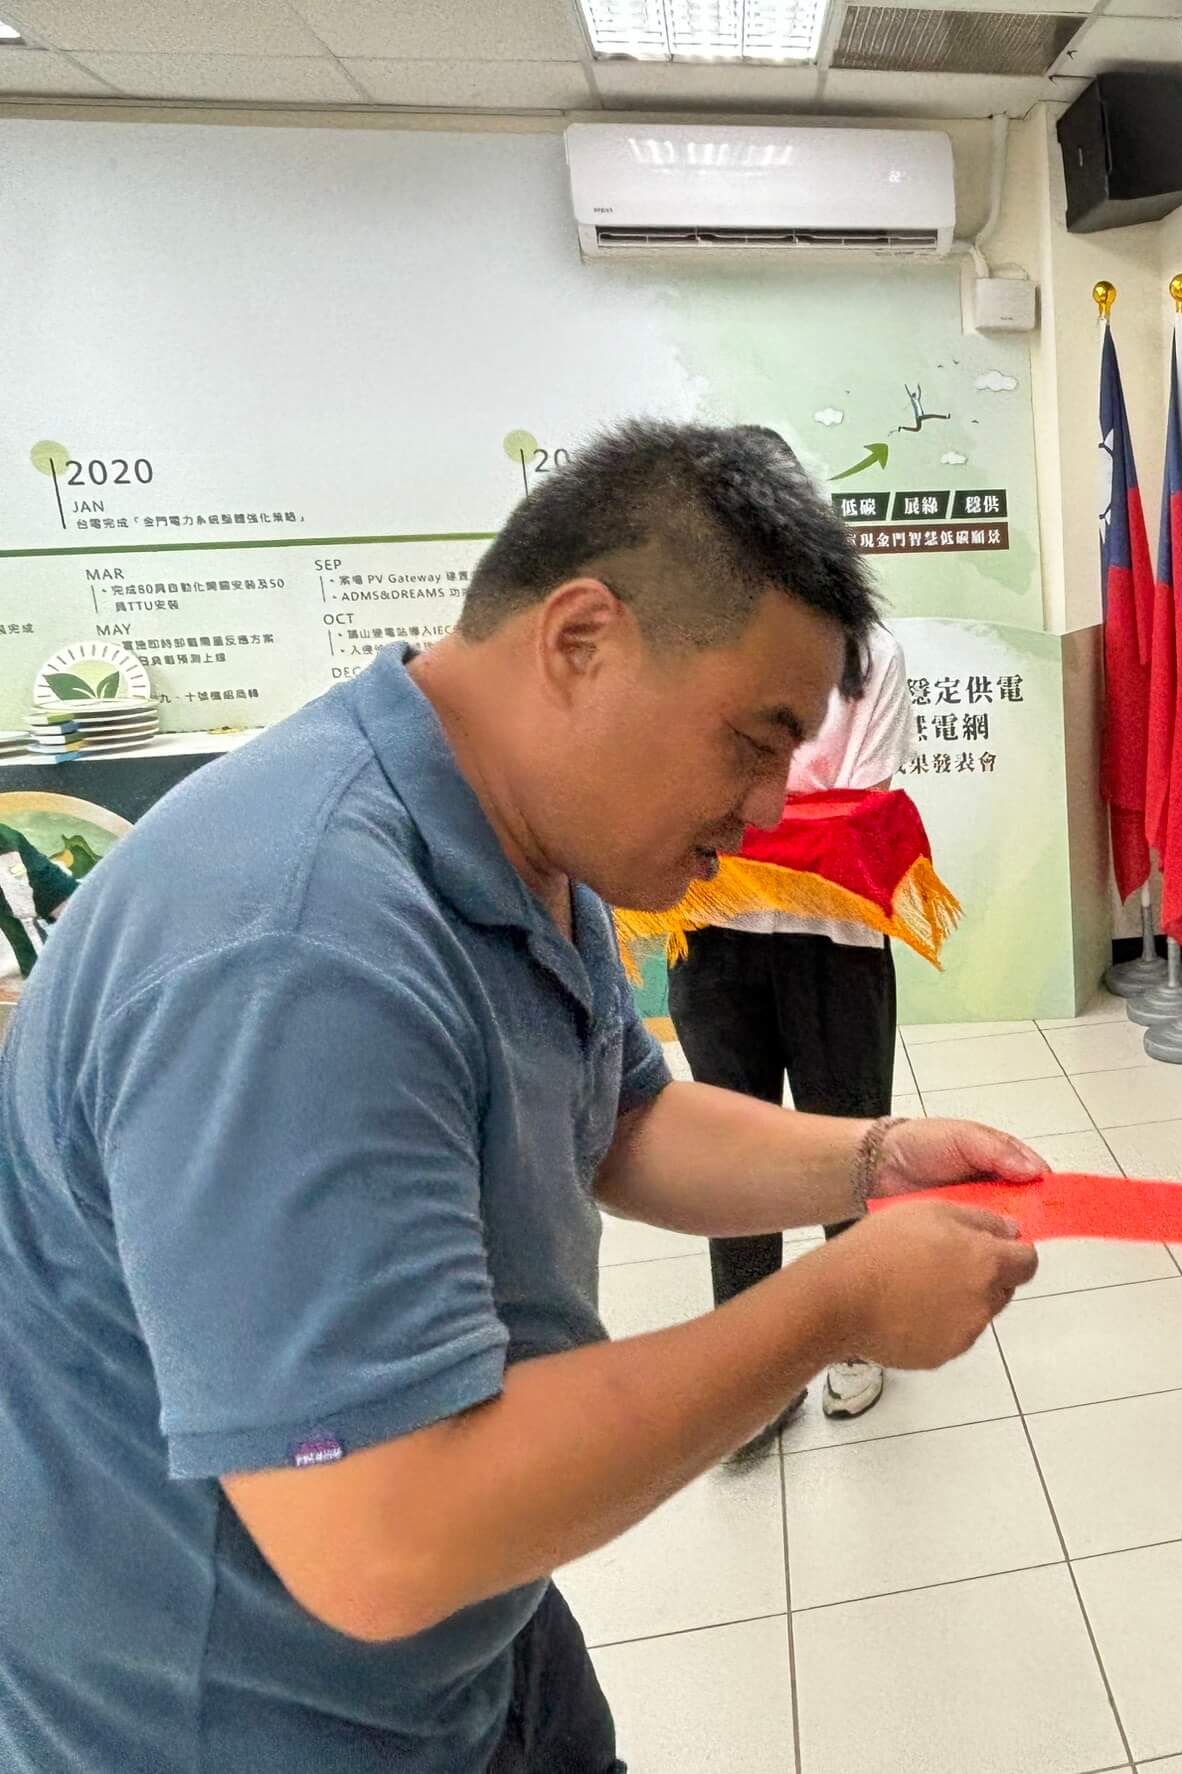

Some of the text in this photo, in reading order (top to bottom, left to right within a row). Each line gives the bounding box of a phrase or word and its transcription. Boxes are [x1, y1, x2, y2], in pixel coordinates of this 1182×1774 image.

[65, 458, 153, 486] 2020
[72, 500, 105, 514] JAN
[841, 498, 877, 516] 低碳
[965, 495, 999, 514] 穩供
[314, 559, 342, 571] SEP
[86, 567, 125, 581] MAR
[367, 575, 383, 585] PV
[388, 573, 441, 585] Gateway
[341, 588, 445, 601] ADMS&DREAMS
[323, 612, 354, 625] OCT
[96, 623, 132, 636] MAY
[899, 751, 997, 775] 果發表會
